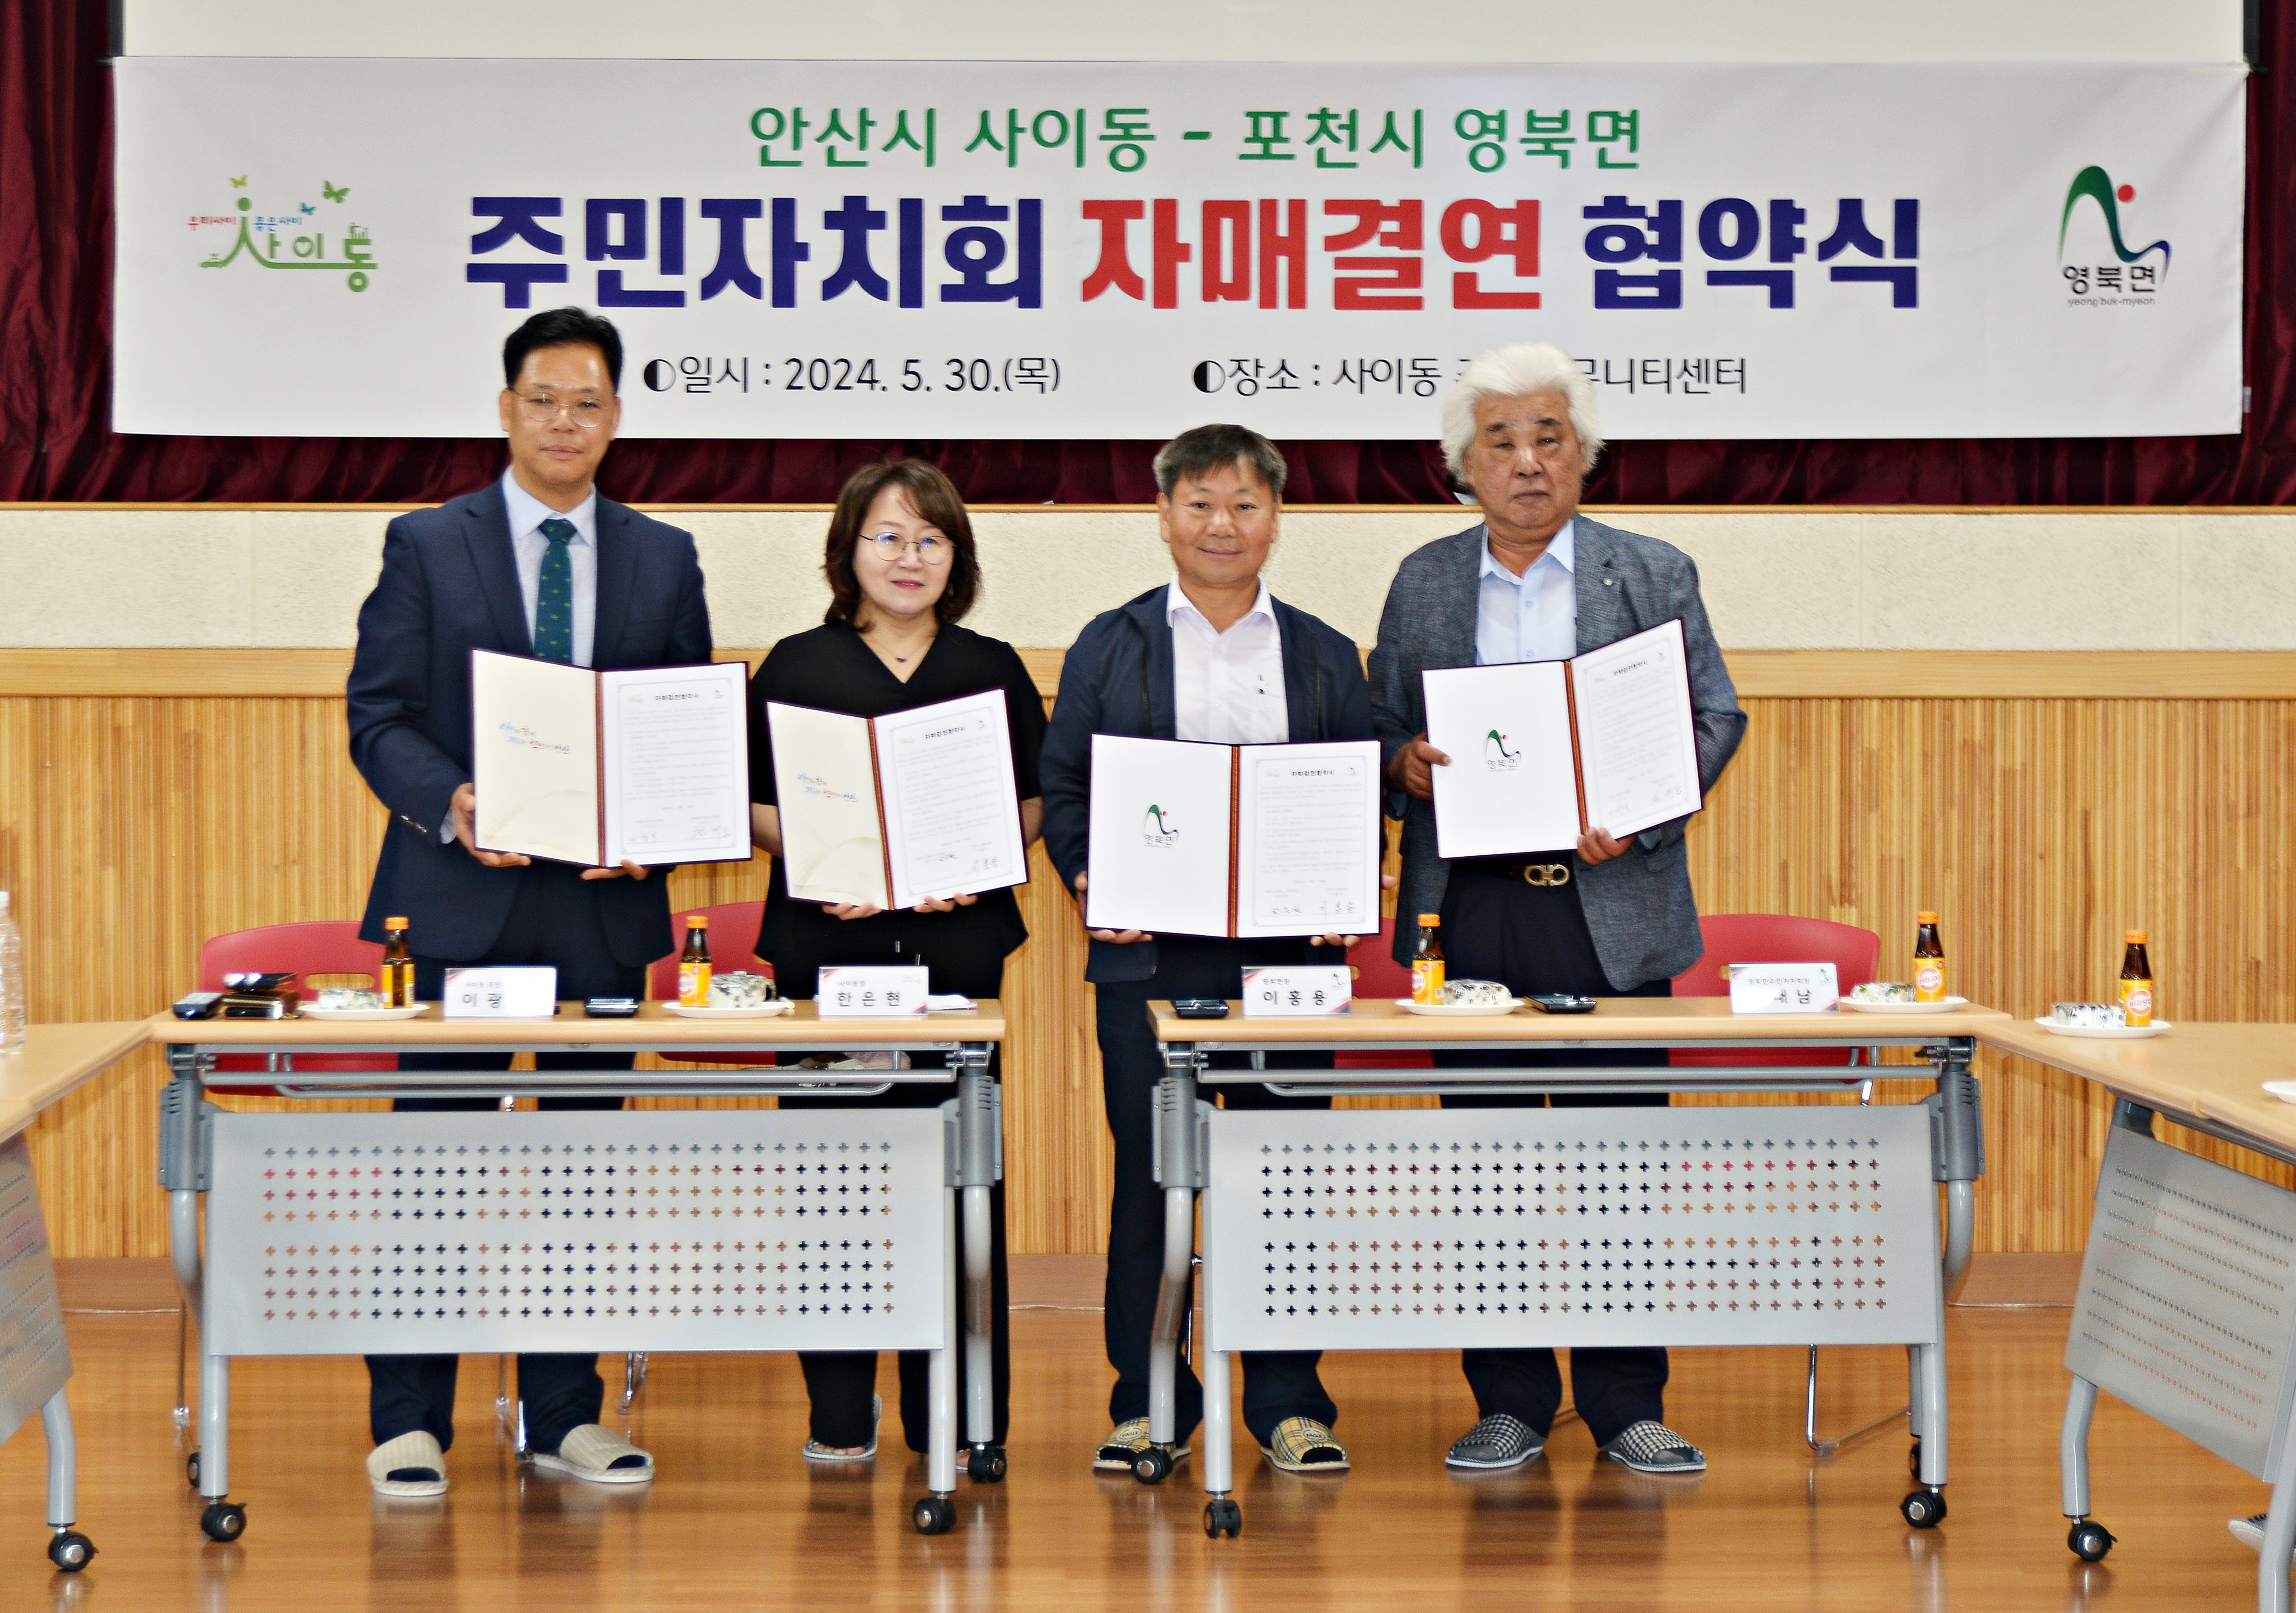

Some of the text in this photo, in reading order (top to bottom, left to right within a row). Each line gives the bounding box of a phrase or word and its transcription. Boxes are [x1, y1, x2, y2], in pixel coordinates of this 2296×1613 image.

[750, 107, 936, 167] 안산시
[964, 108, 1156, 172] 사이동
[1238, 107, 1423, 169] 포천시
[1455, 109, 1639, 173] 영북면
[188, 216, 236, 231] 우리사이
[254, 216, 302, 231] 좋은사이
[200, 197, 378, 293] 사이동
[466, 195, 1920, 310] 주민자치회 자매결연 협약식
[2063, 266, 2155, 295] 영북면
[2068, 298, 2098, 307] yeong
[680, 356, 749, 393] 일시
[784, 358, 888, 392] 2024.
[902, 359, 932, 392] 5.
[945, 357, 1061, 394] 30.(목)
[1229, 358, 1300, 396] 장소
[1333, 358, 1443, 397] 사이동
